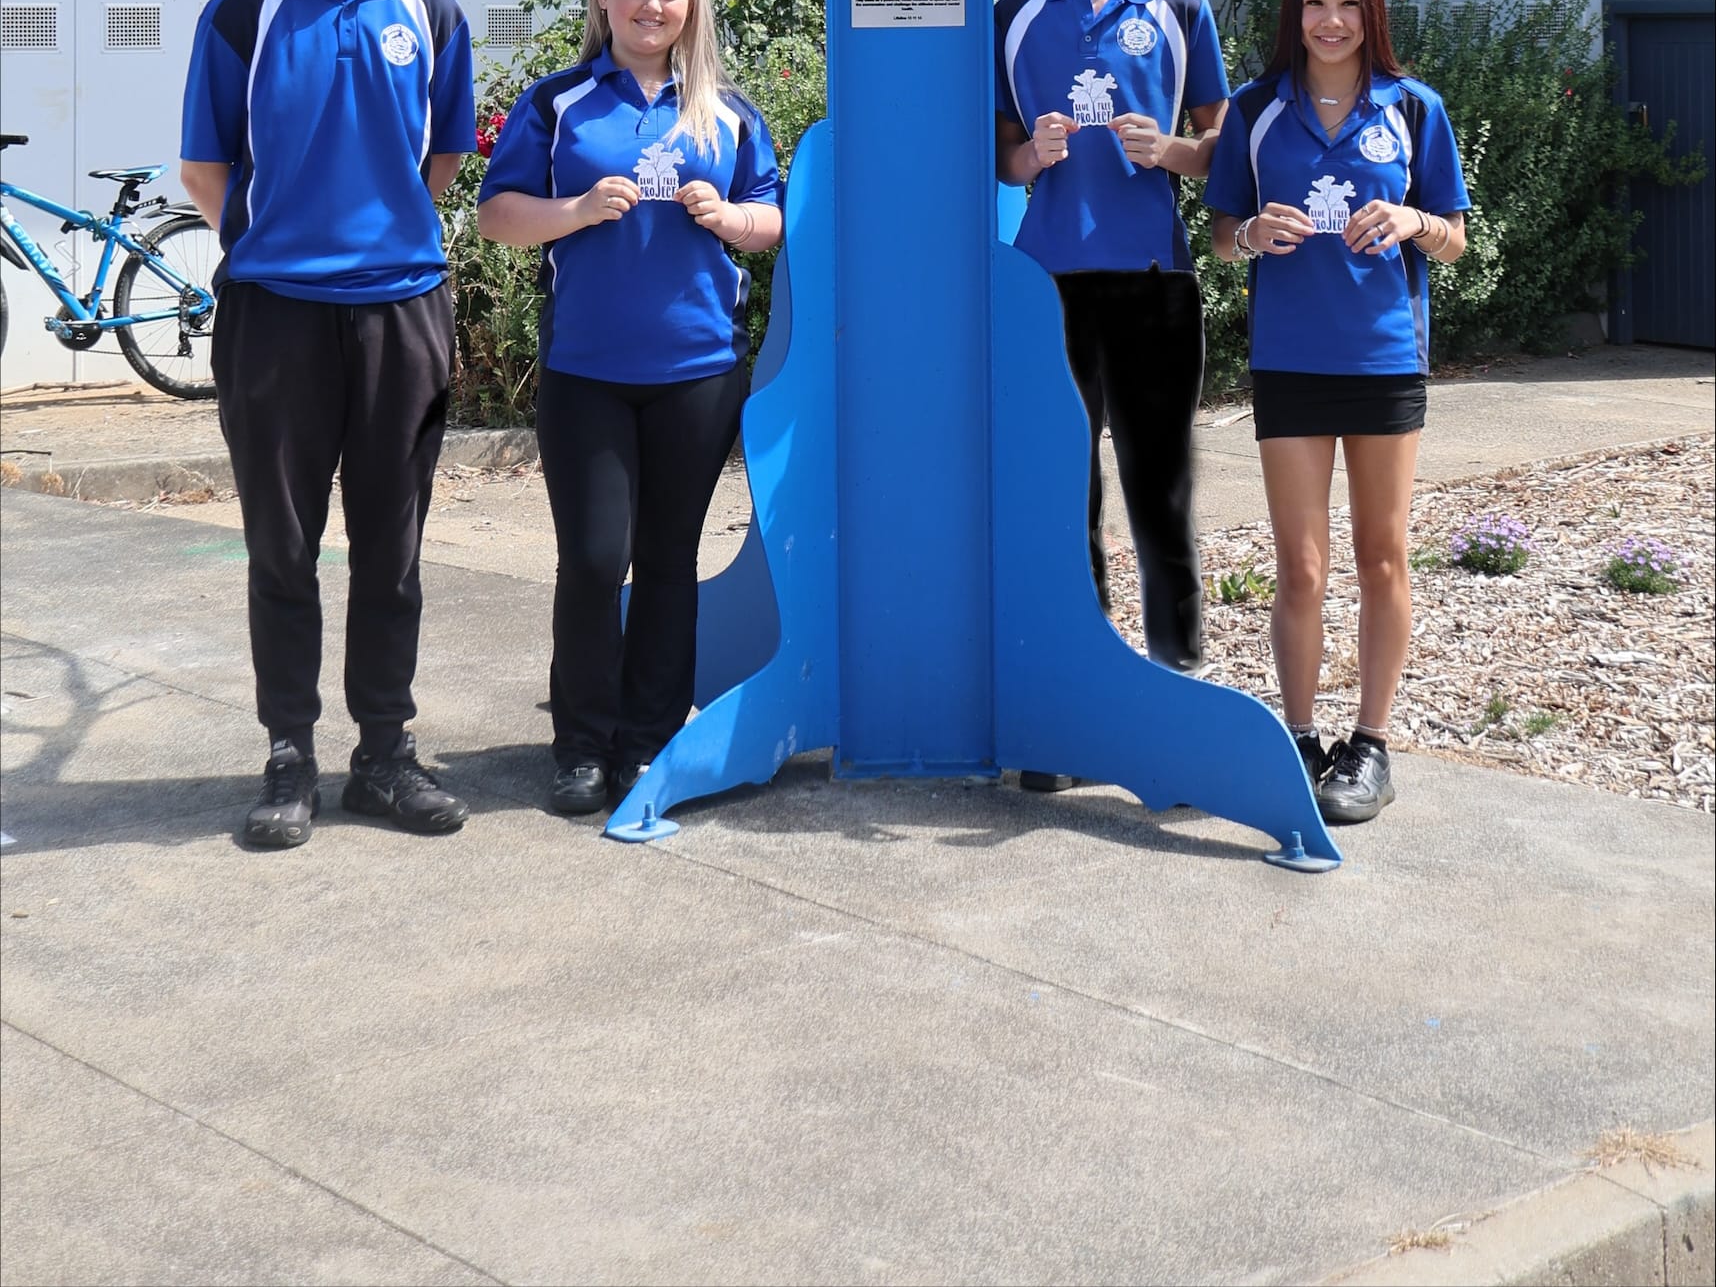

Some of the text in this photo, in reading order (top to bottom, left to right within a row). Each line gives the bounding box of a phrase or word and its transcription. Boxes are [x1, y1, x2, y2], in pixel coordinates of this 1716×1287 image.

[1075, 102, 1111, 111] BLUE TREE
[1076, 111, 1112, 124] PROJECT
[640, 177, 676, 185] BLUE TREE
[640, 186, 676, 198] PROJECT
[1311, 209, 1348, 218] BLUE TREE
